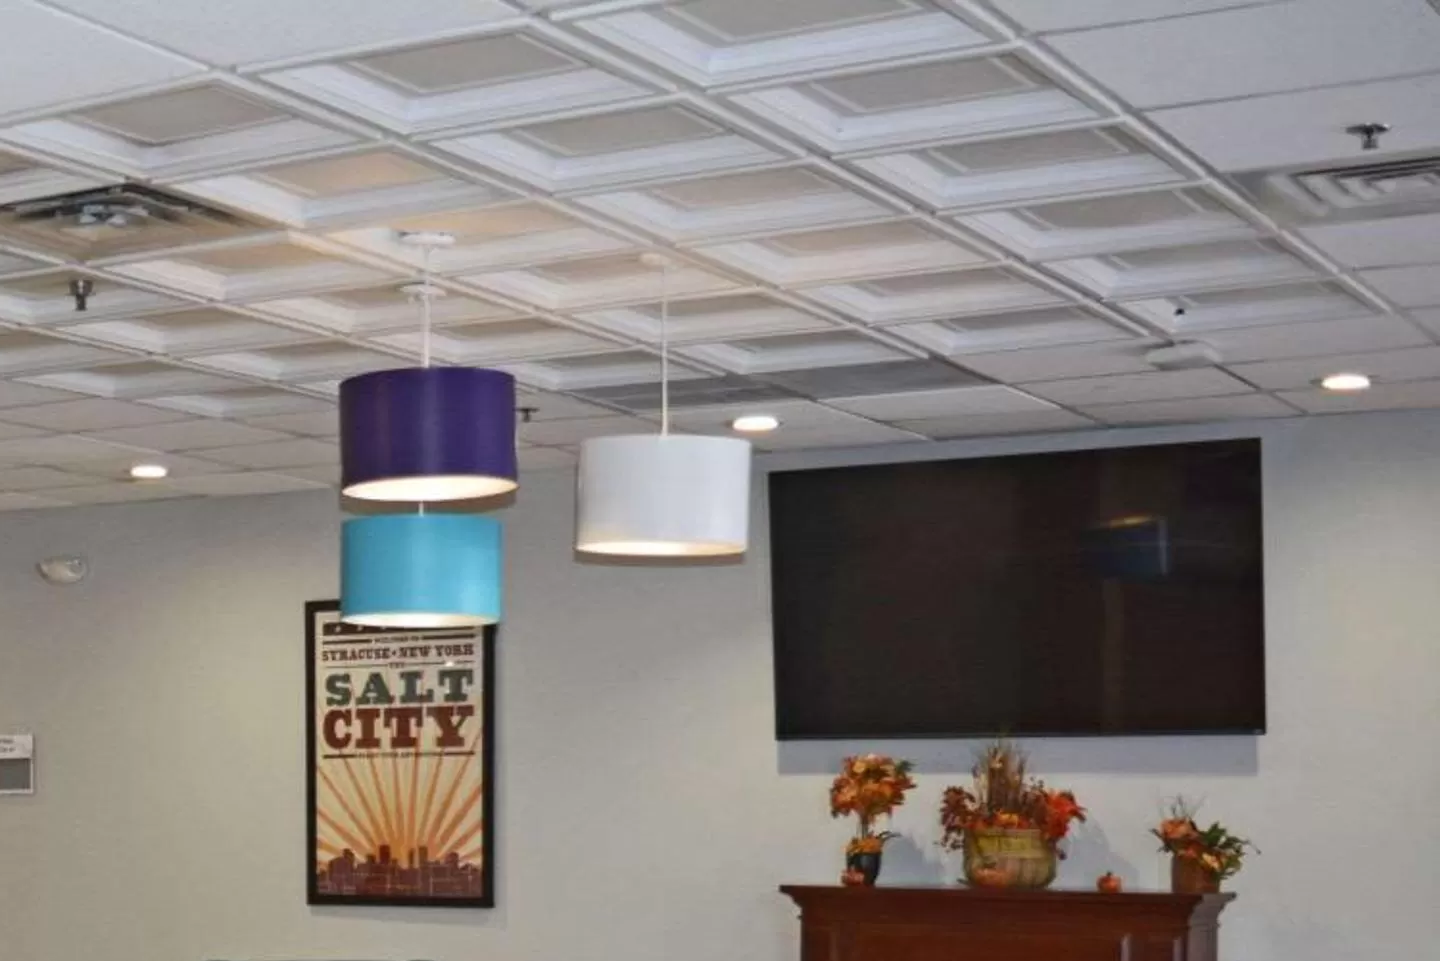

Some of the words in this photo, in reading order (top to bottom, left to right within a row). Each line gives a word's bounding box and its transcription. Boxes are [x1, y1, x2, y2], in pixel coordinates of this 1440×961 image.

[434, 644, 474, 656] YORK
[325, 669, 474, 706] SALT
[323, 705, 474, 749] CITY
